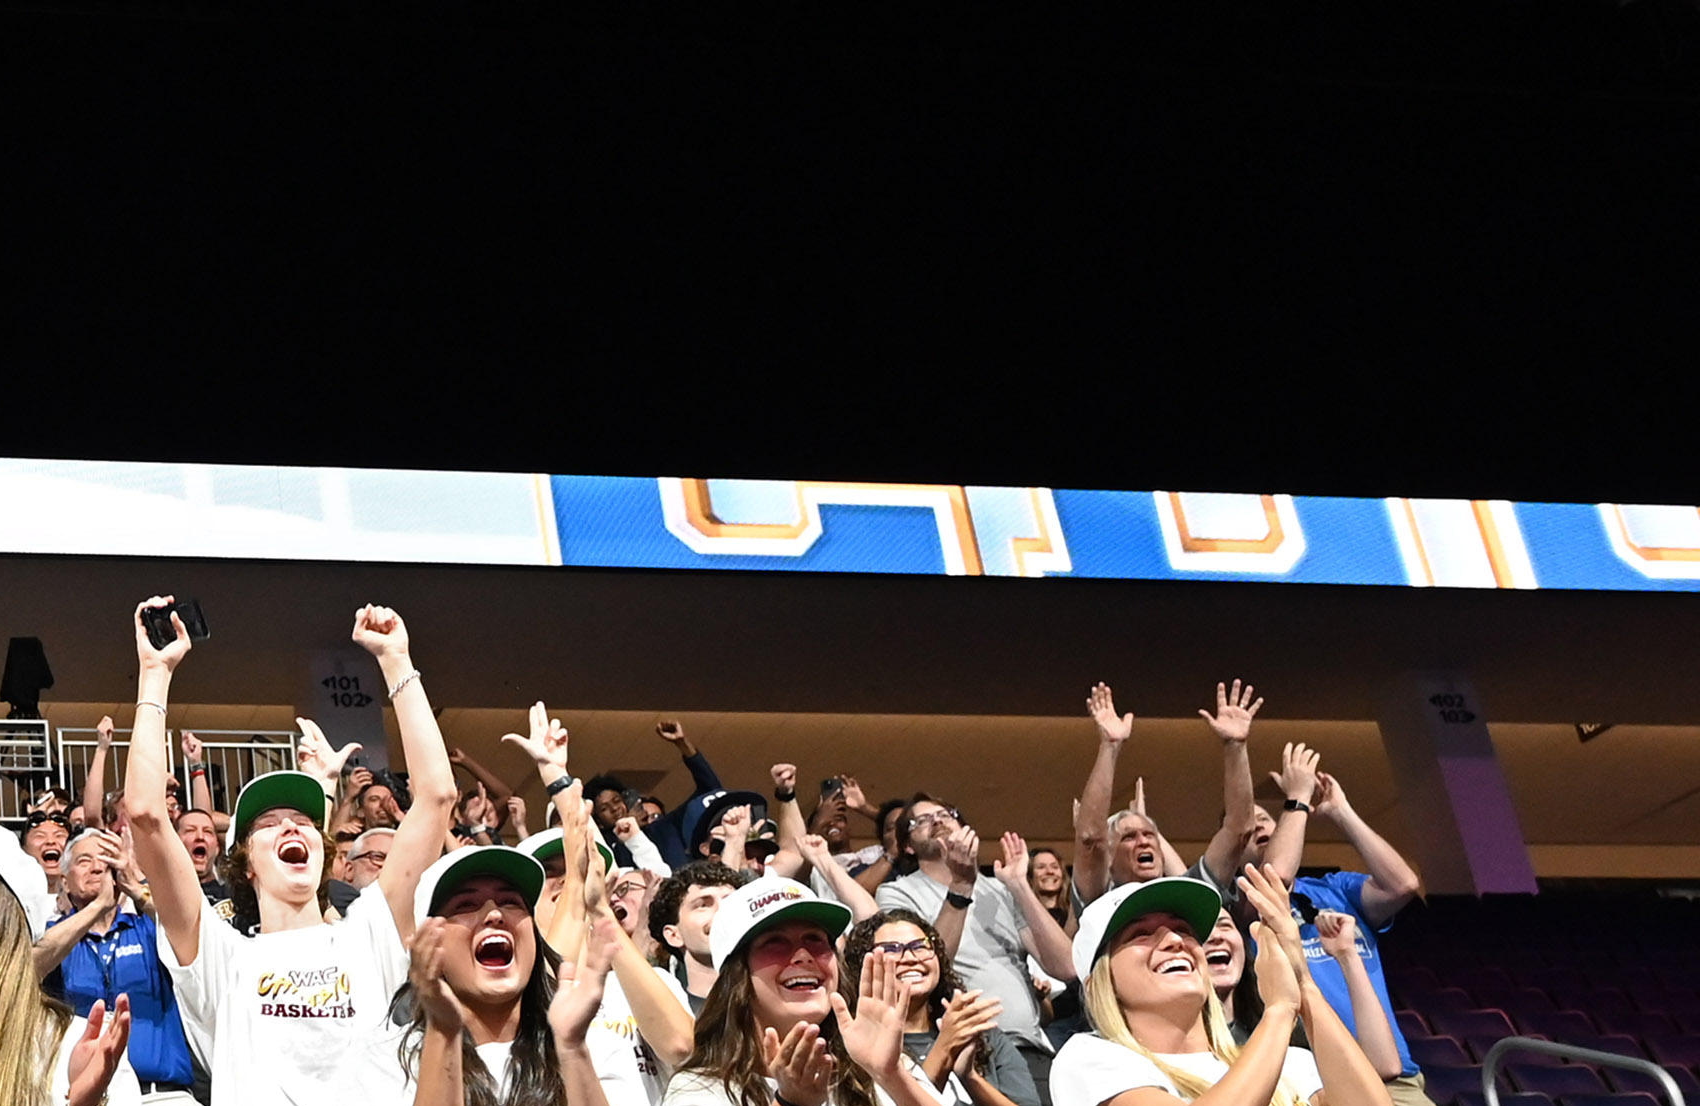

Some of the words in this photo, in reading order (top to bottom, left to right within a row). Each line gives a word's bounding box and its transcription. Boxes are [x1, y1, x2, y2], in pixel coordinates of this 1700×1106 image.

[329, 676, 360, 690] 101
[331, 692, 365, 707] 102
[289, 966, 338, 987] WAC
